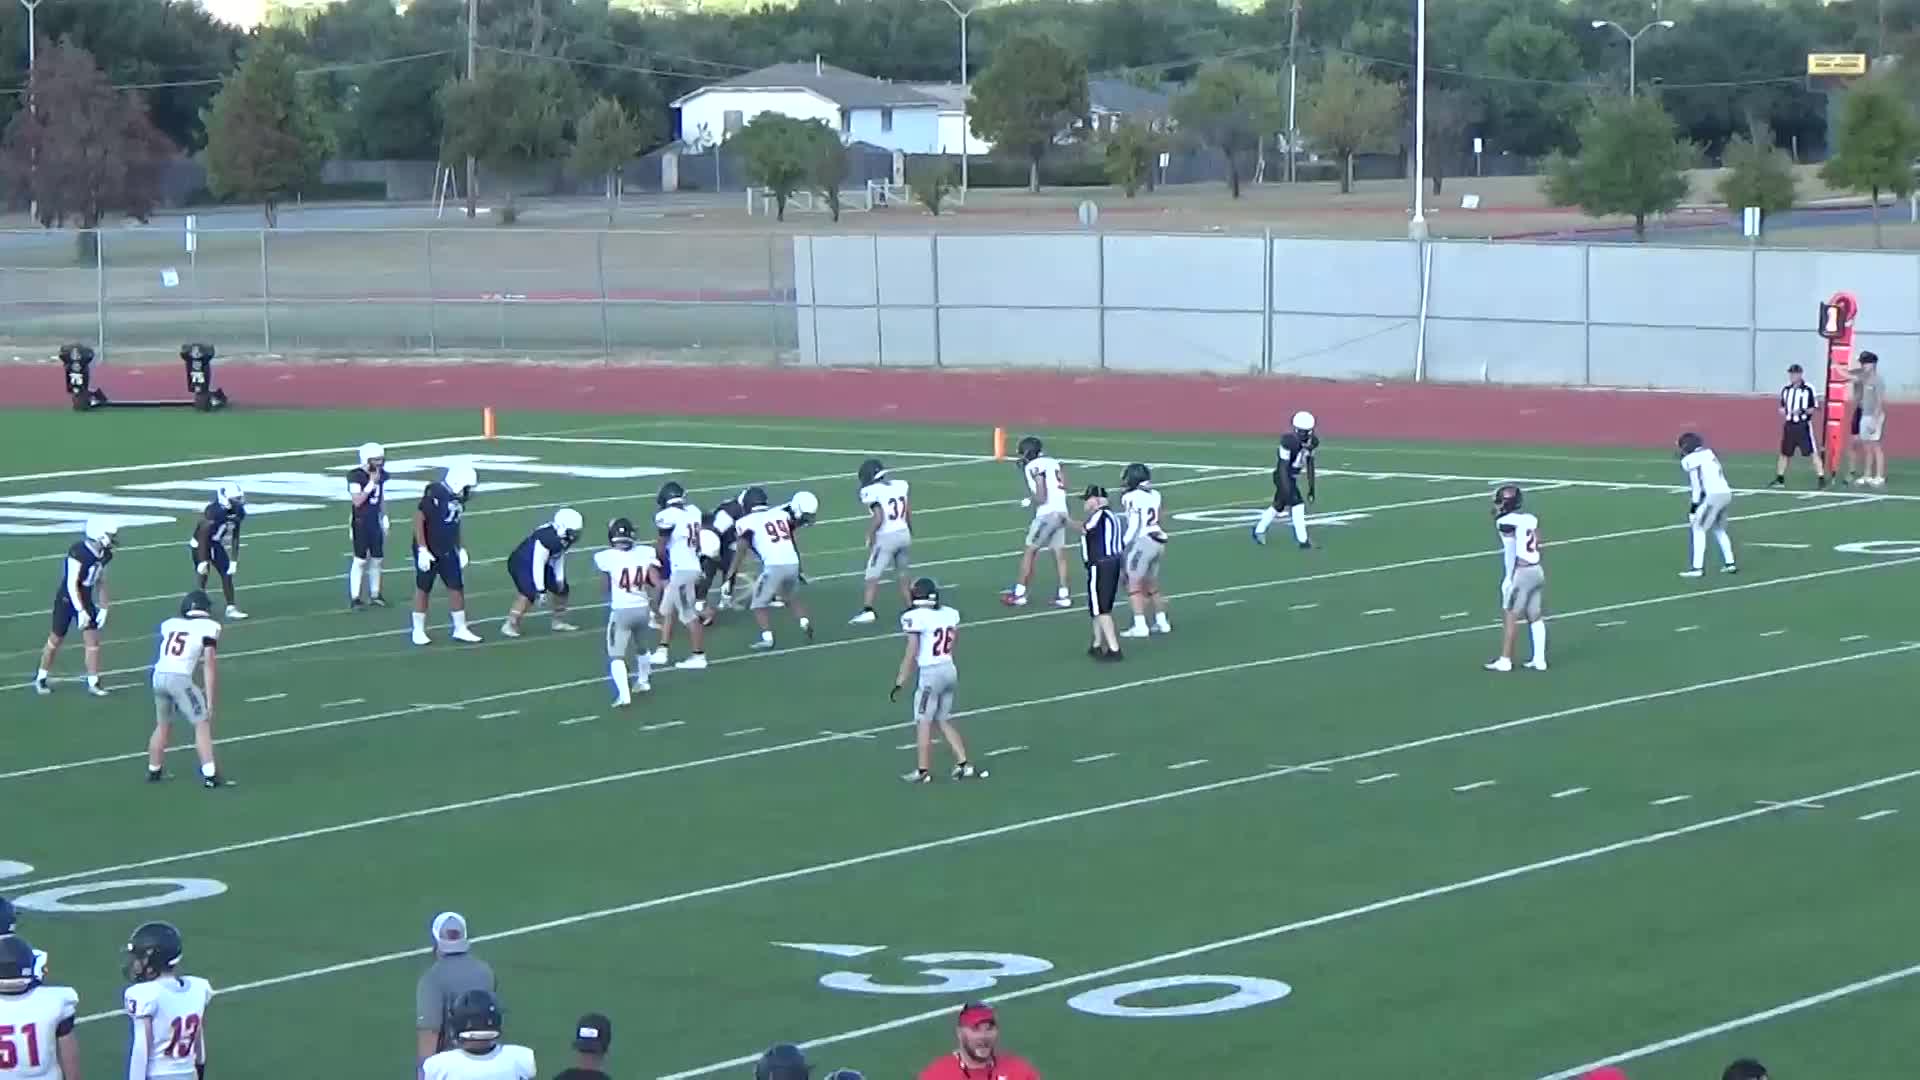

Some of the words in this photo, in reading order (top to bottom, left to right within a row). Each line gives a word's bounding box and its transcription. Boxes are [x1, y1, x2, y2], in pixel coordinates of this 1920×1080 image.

[1826, 305, 1838, 332] 1
[888, 495, 906, 520] 37
[764, 518, 793, 543] 99
[619, 567, 647, 593] 44
[164, 631, 189, 657] 15
[0, 1022, 41, 1069] 51
[164, 1013, 200, 1058] 13
